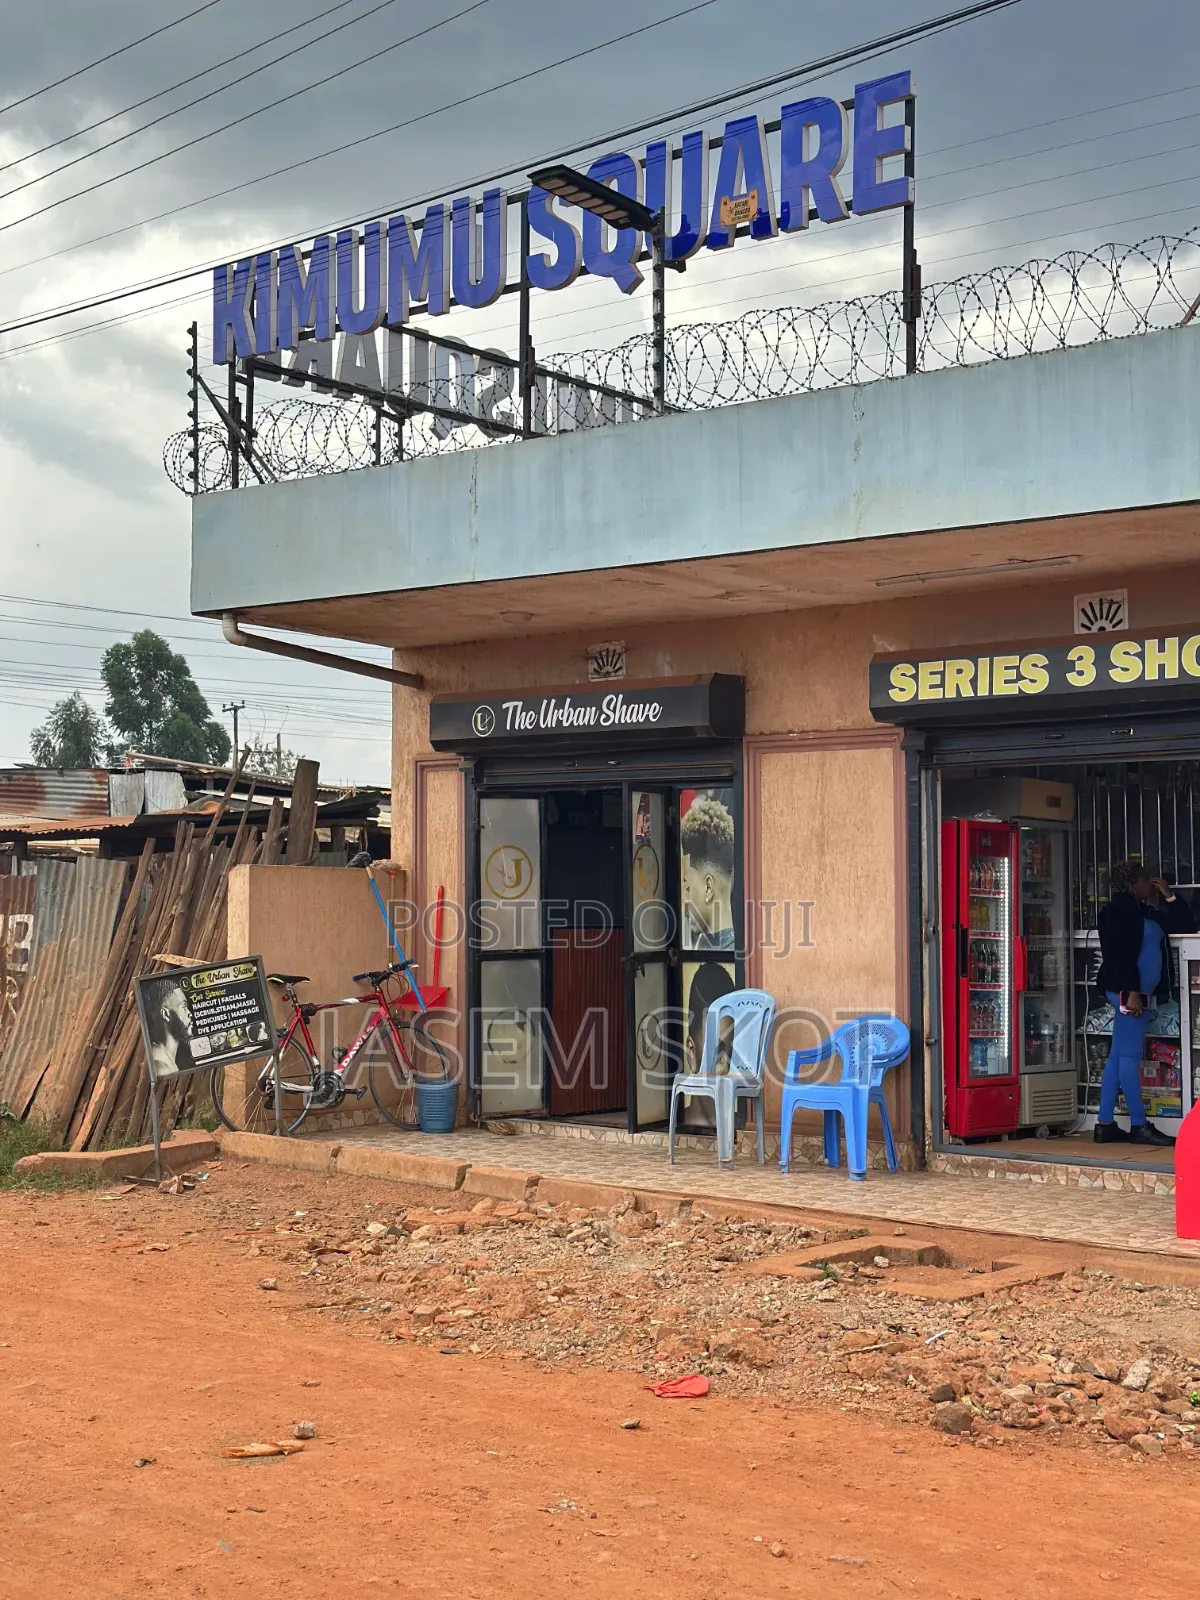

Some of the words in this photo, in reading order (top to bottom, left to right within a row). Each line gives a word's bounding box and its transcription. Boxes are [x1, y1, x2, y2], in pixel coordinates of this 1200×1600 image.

[213, 187, 507, 365] KIMUMU
[526, 69, 917, 295] SQUARE
[888, 653, 1050, 702] SERIES
[1065, 645, 1097, 687] 3
[501, 701, 537, 731] The
[539, 698, 599, 729] Urban
[599, 693, 663, 725] Shave
[193, 975, 206, 987] The
[207, 971, 230, 983] Urban
[233, 966, 253, 979] Shave
[192, 999, 217, 1010] HAIRCUT
[221, 993, 246, 1003] FACIALS
[195, 1013, 227, 1026] PEDICURES
[231, 1006, 260, 1018] MASSAGE
[198, 1026, 210, 1035] DYE
[210, 1017, 248, 1031] APPLICATION
[342, 1025, 375, 1068] DAWES
